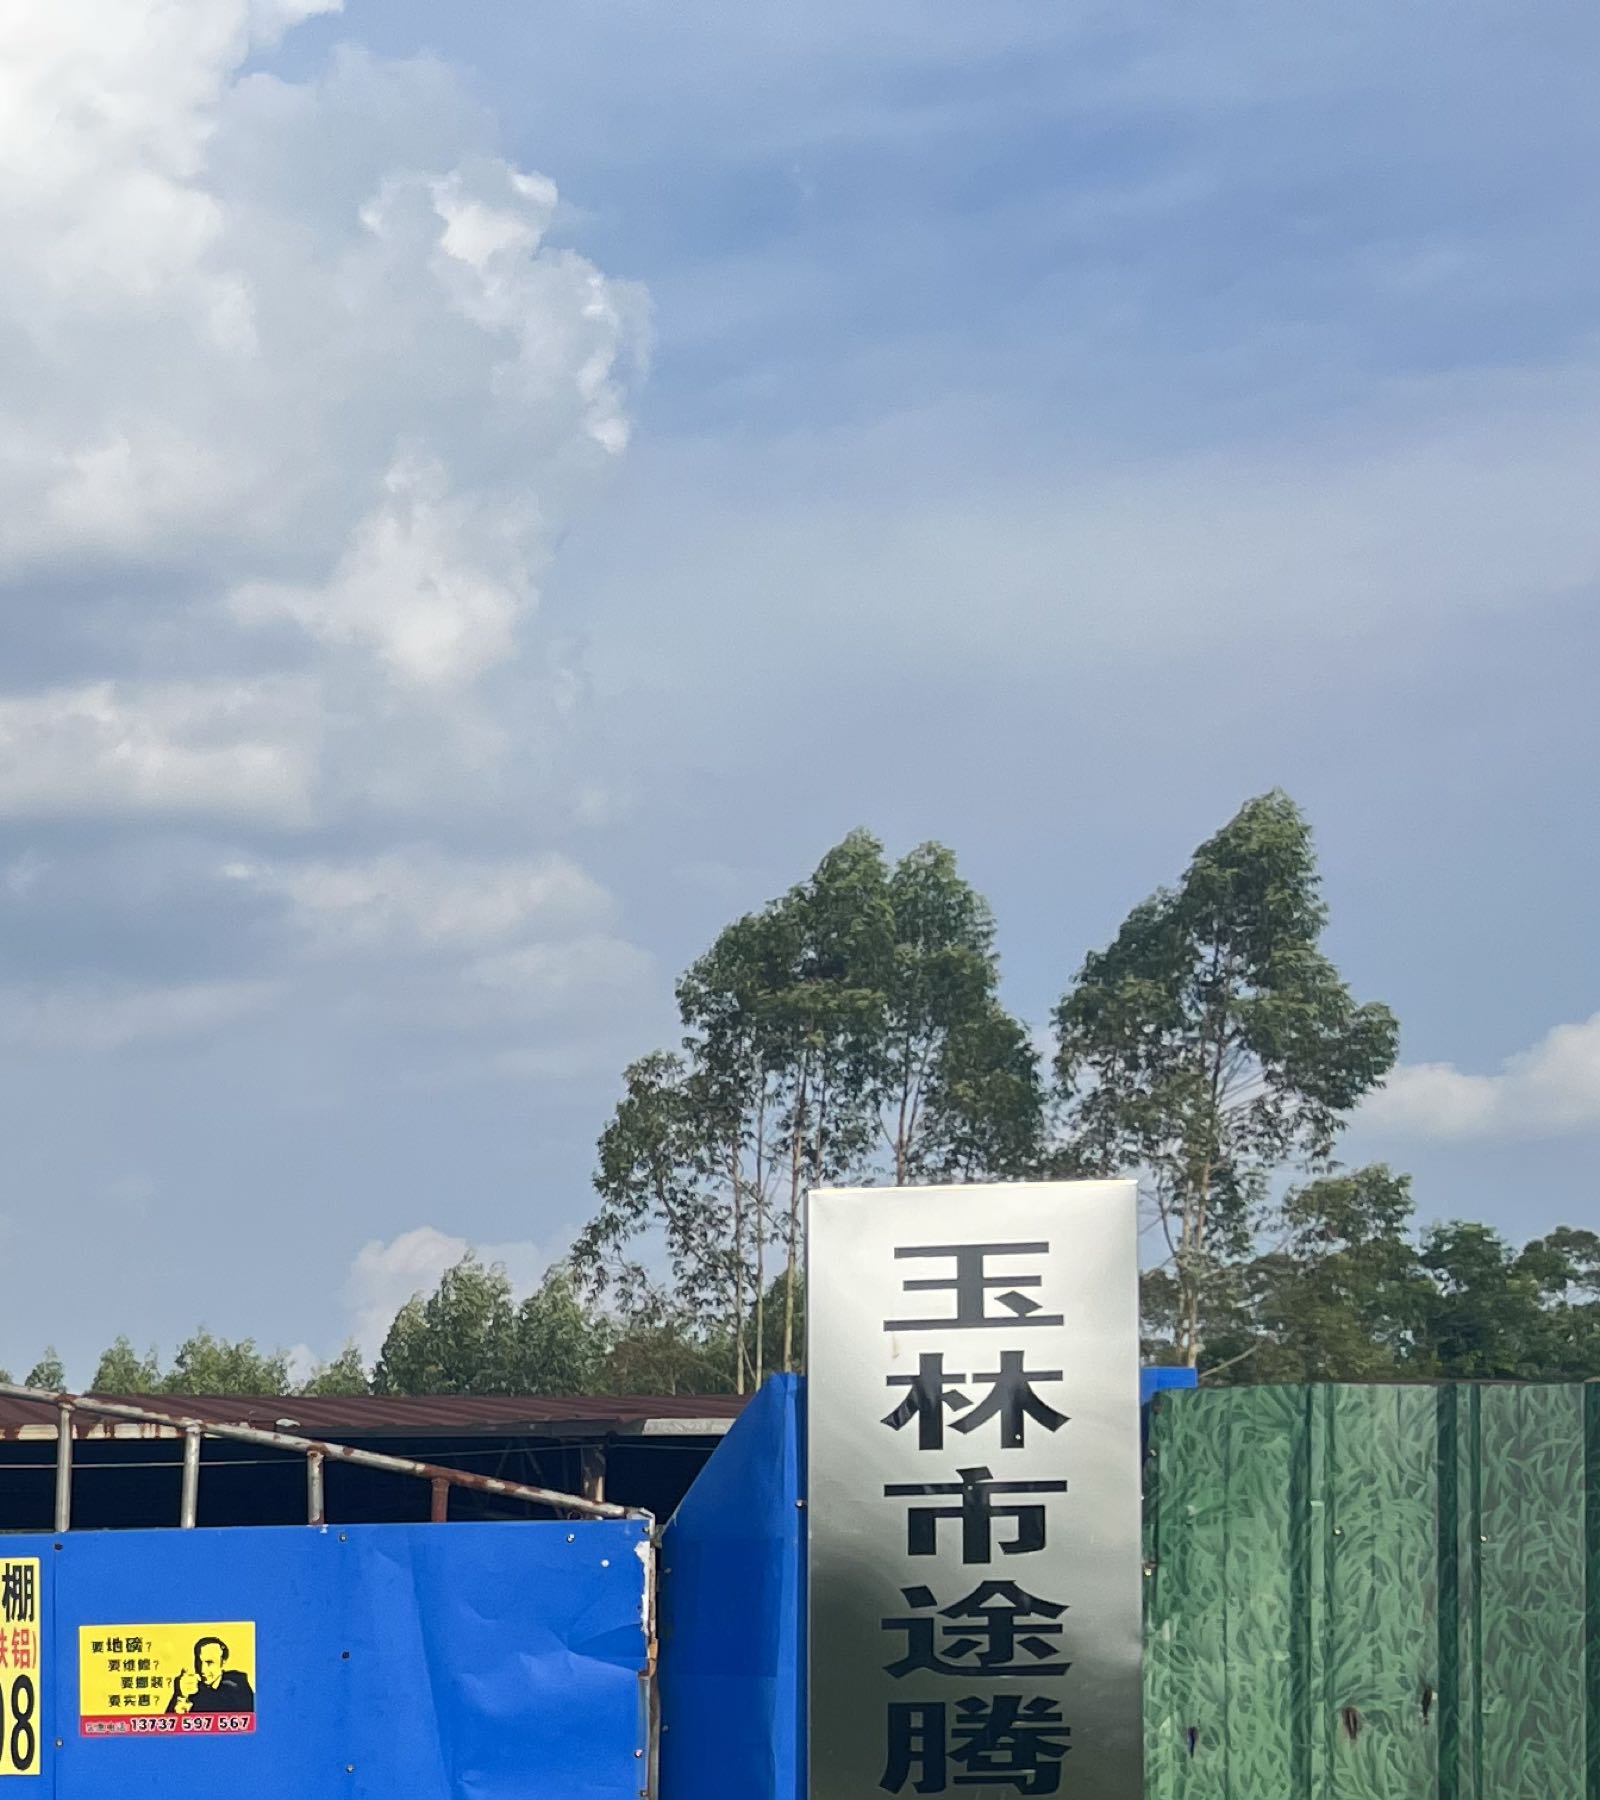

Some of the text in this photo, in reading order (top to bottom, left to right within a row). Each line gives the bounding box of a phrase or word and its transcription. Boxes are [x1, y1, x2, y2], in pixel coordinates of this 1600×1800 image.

[131, 1718, 176, 1732] 13737
[181, 1717, 213, 1732] 597
[218, 1716, 250, 1731] 567
